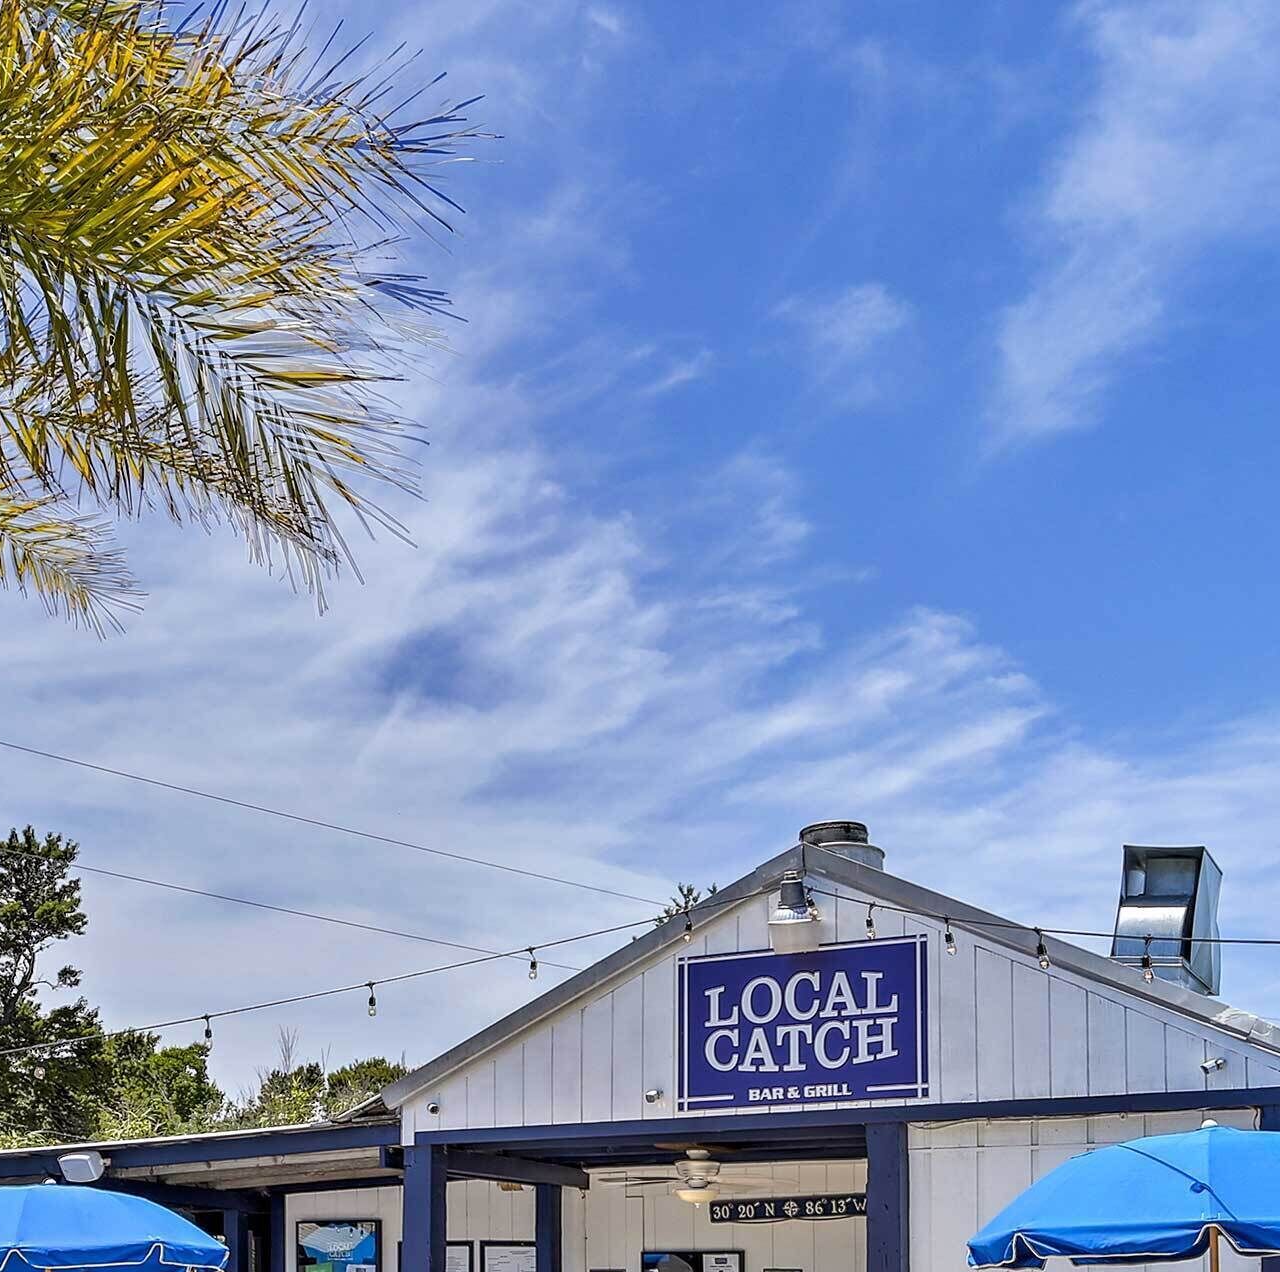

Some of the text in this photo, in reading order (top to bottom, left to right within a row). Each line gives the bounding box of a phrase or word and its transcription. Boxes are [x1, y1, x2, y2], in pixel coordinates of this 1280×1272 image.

[703, 970, 898, 1028] LOCAL
[704, 1016, 899, 1073] CATCH
[748, 1083, 853, 1101] BAR & GRILL
[764, 1203, 775, 1217] N
